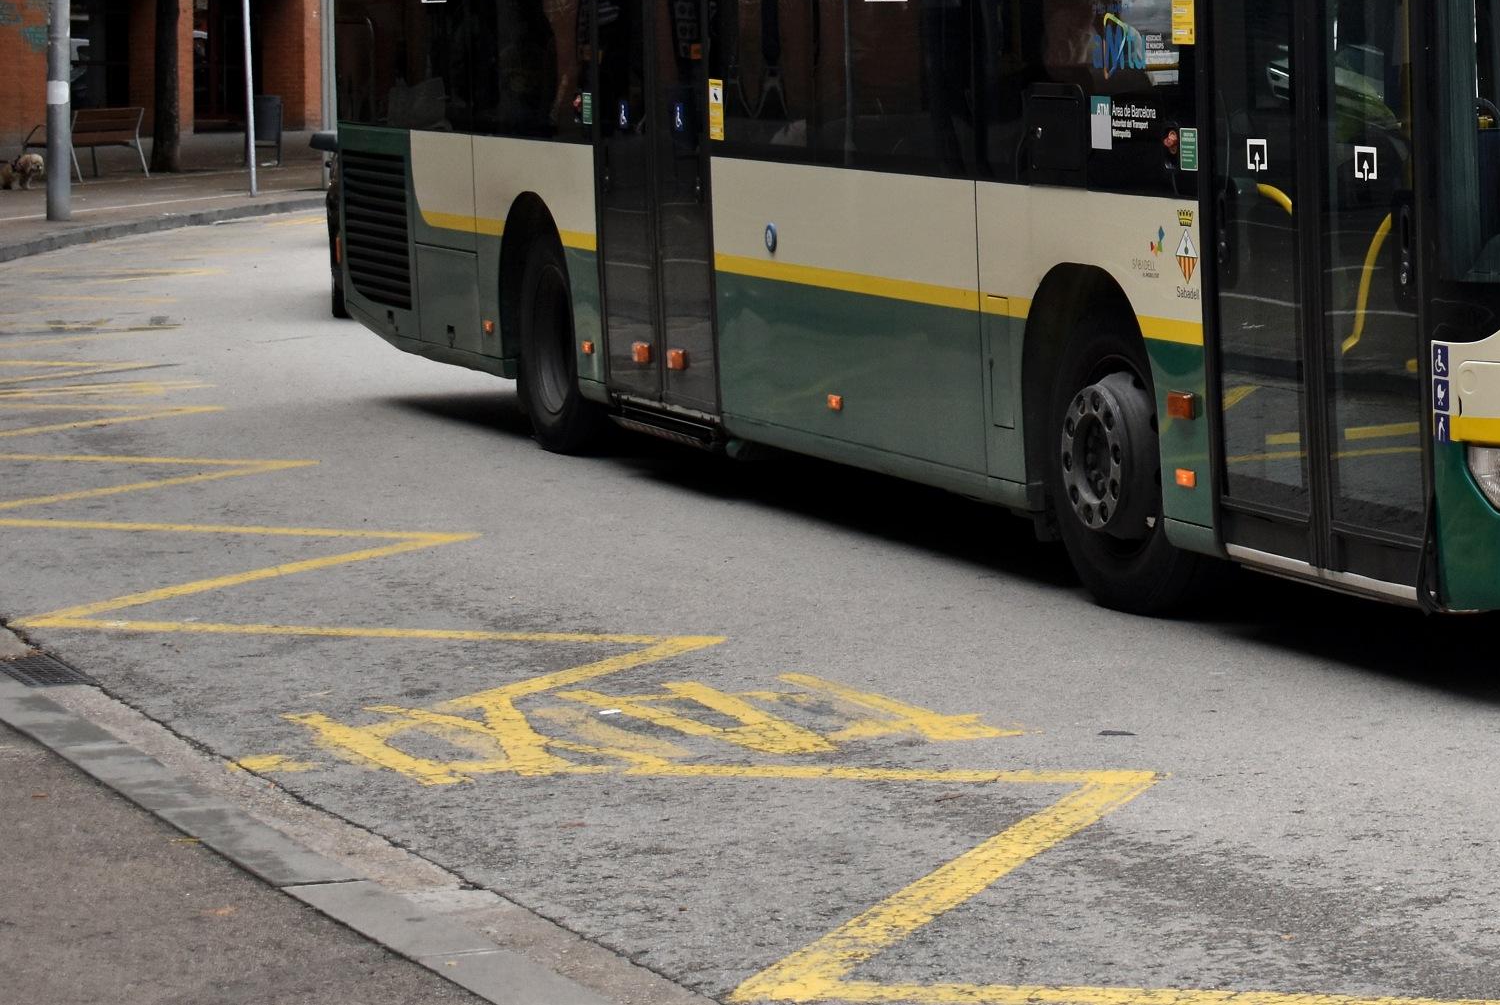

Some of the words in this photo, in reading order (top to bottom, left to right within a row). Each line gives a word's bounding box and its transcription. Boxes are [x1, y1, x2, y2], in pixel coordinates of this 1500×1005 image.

[1096, 103, 1110, 116] ATM
[1124, 104, 1130, 117] de
[1131, 104, 1156, 118] Barcelona
[1176, 286, 1200, 300] Sabadell
